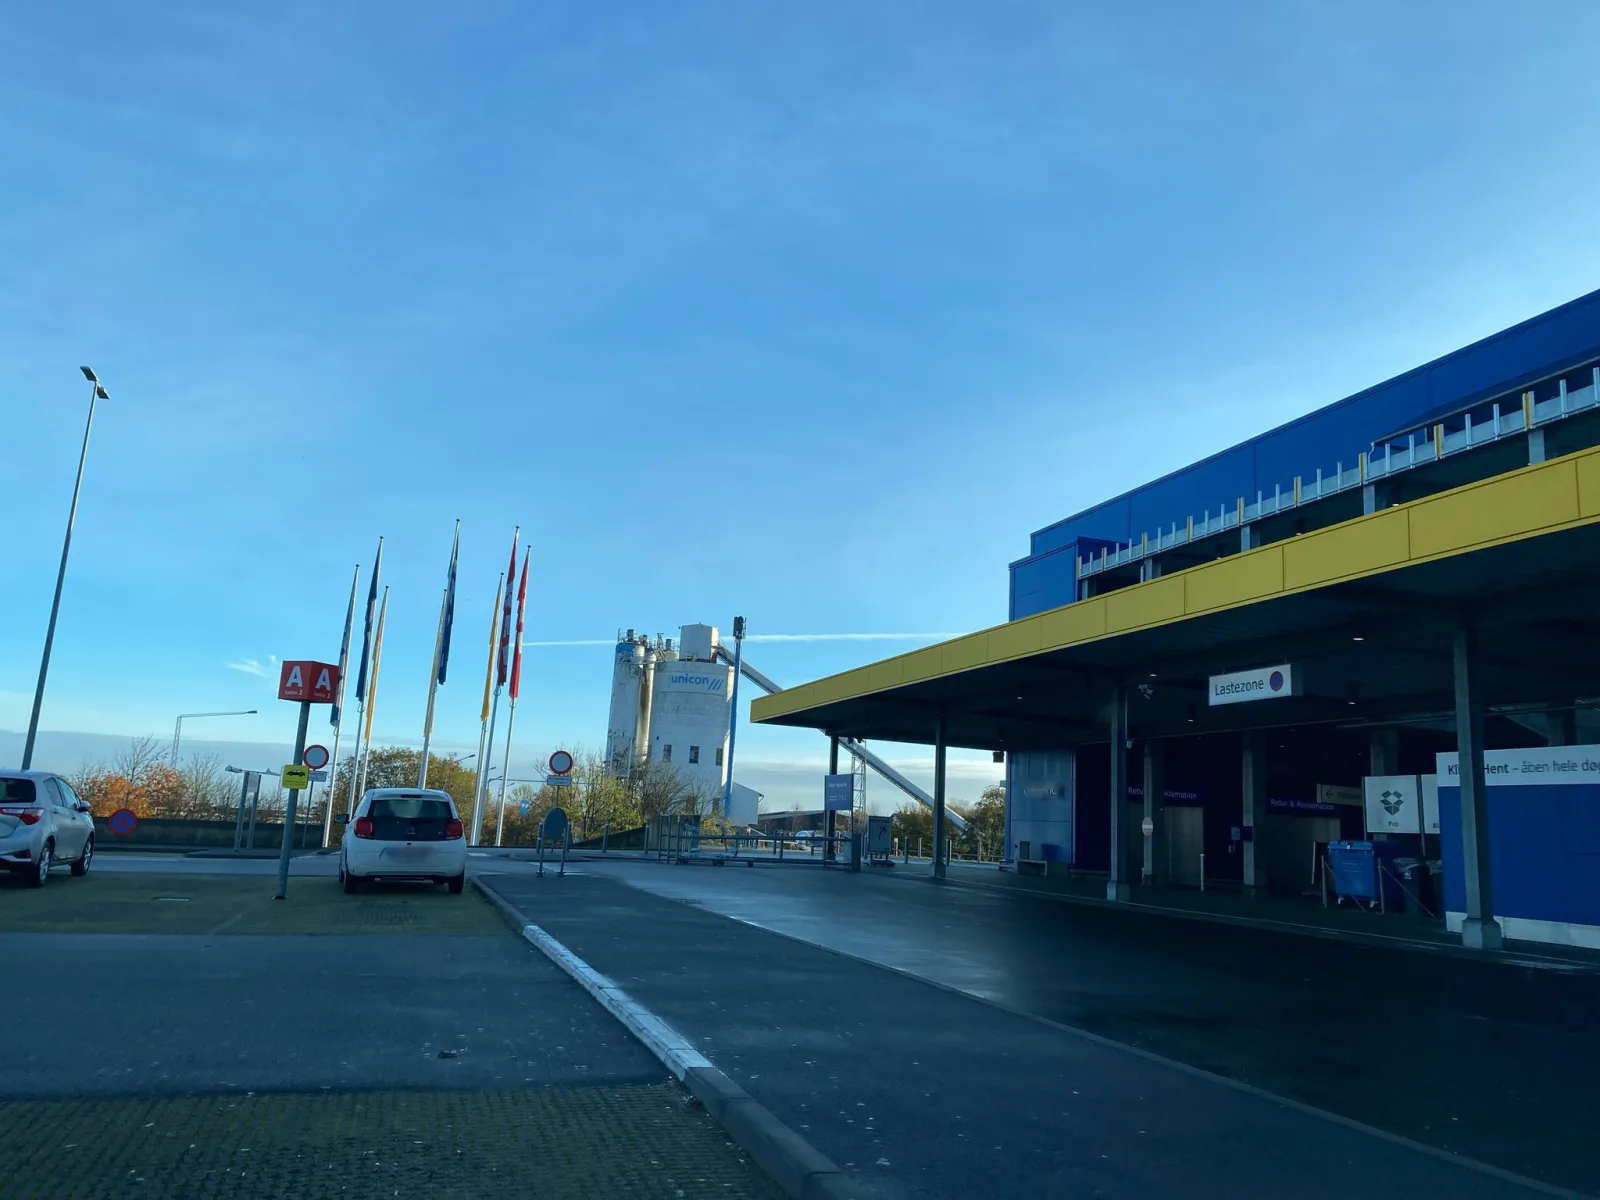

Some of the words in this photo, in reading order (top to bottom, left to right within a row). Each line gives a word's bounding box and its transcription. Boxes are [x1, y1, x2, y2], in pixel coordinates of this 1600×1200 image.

[286, 665, 303, 688] A
[315, 668, 331, 691] A
[671, 673, 709, 685] unicon
[1215, 680, 1264, 696] Lastezone
[1553, 760, 1577, 772] hele
[1581, 758, 1600, 774] dø
[1128, 786, 1144, 795] Retu
[1165, 789, 1197, 800] klamation
